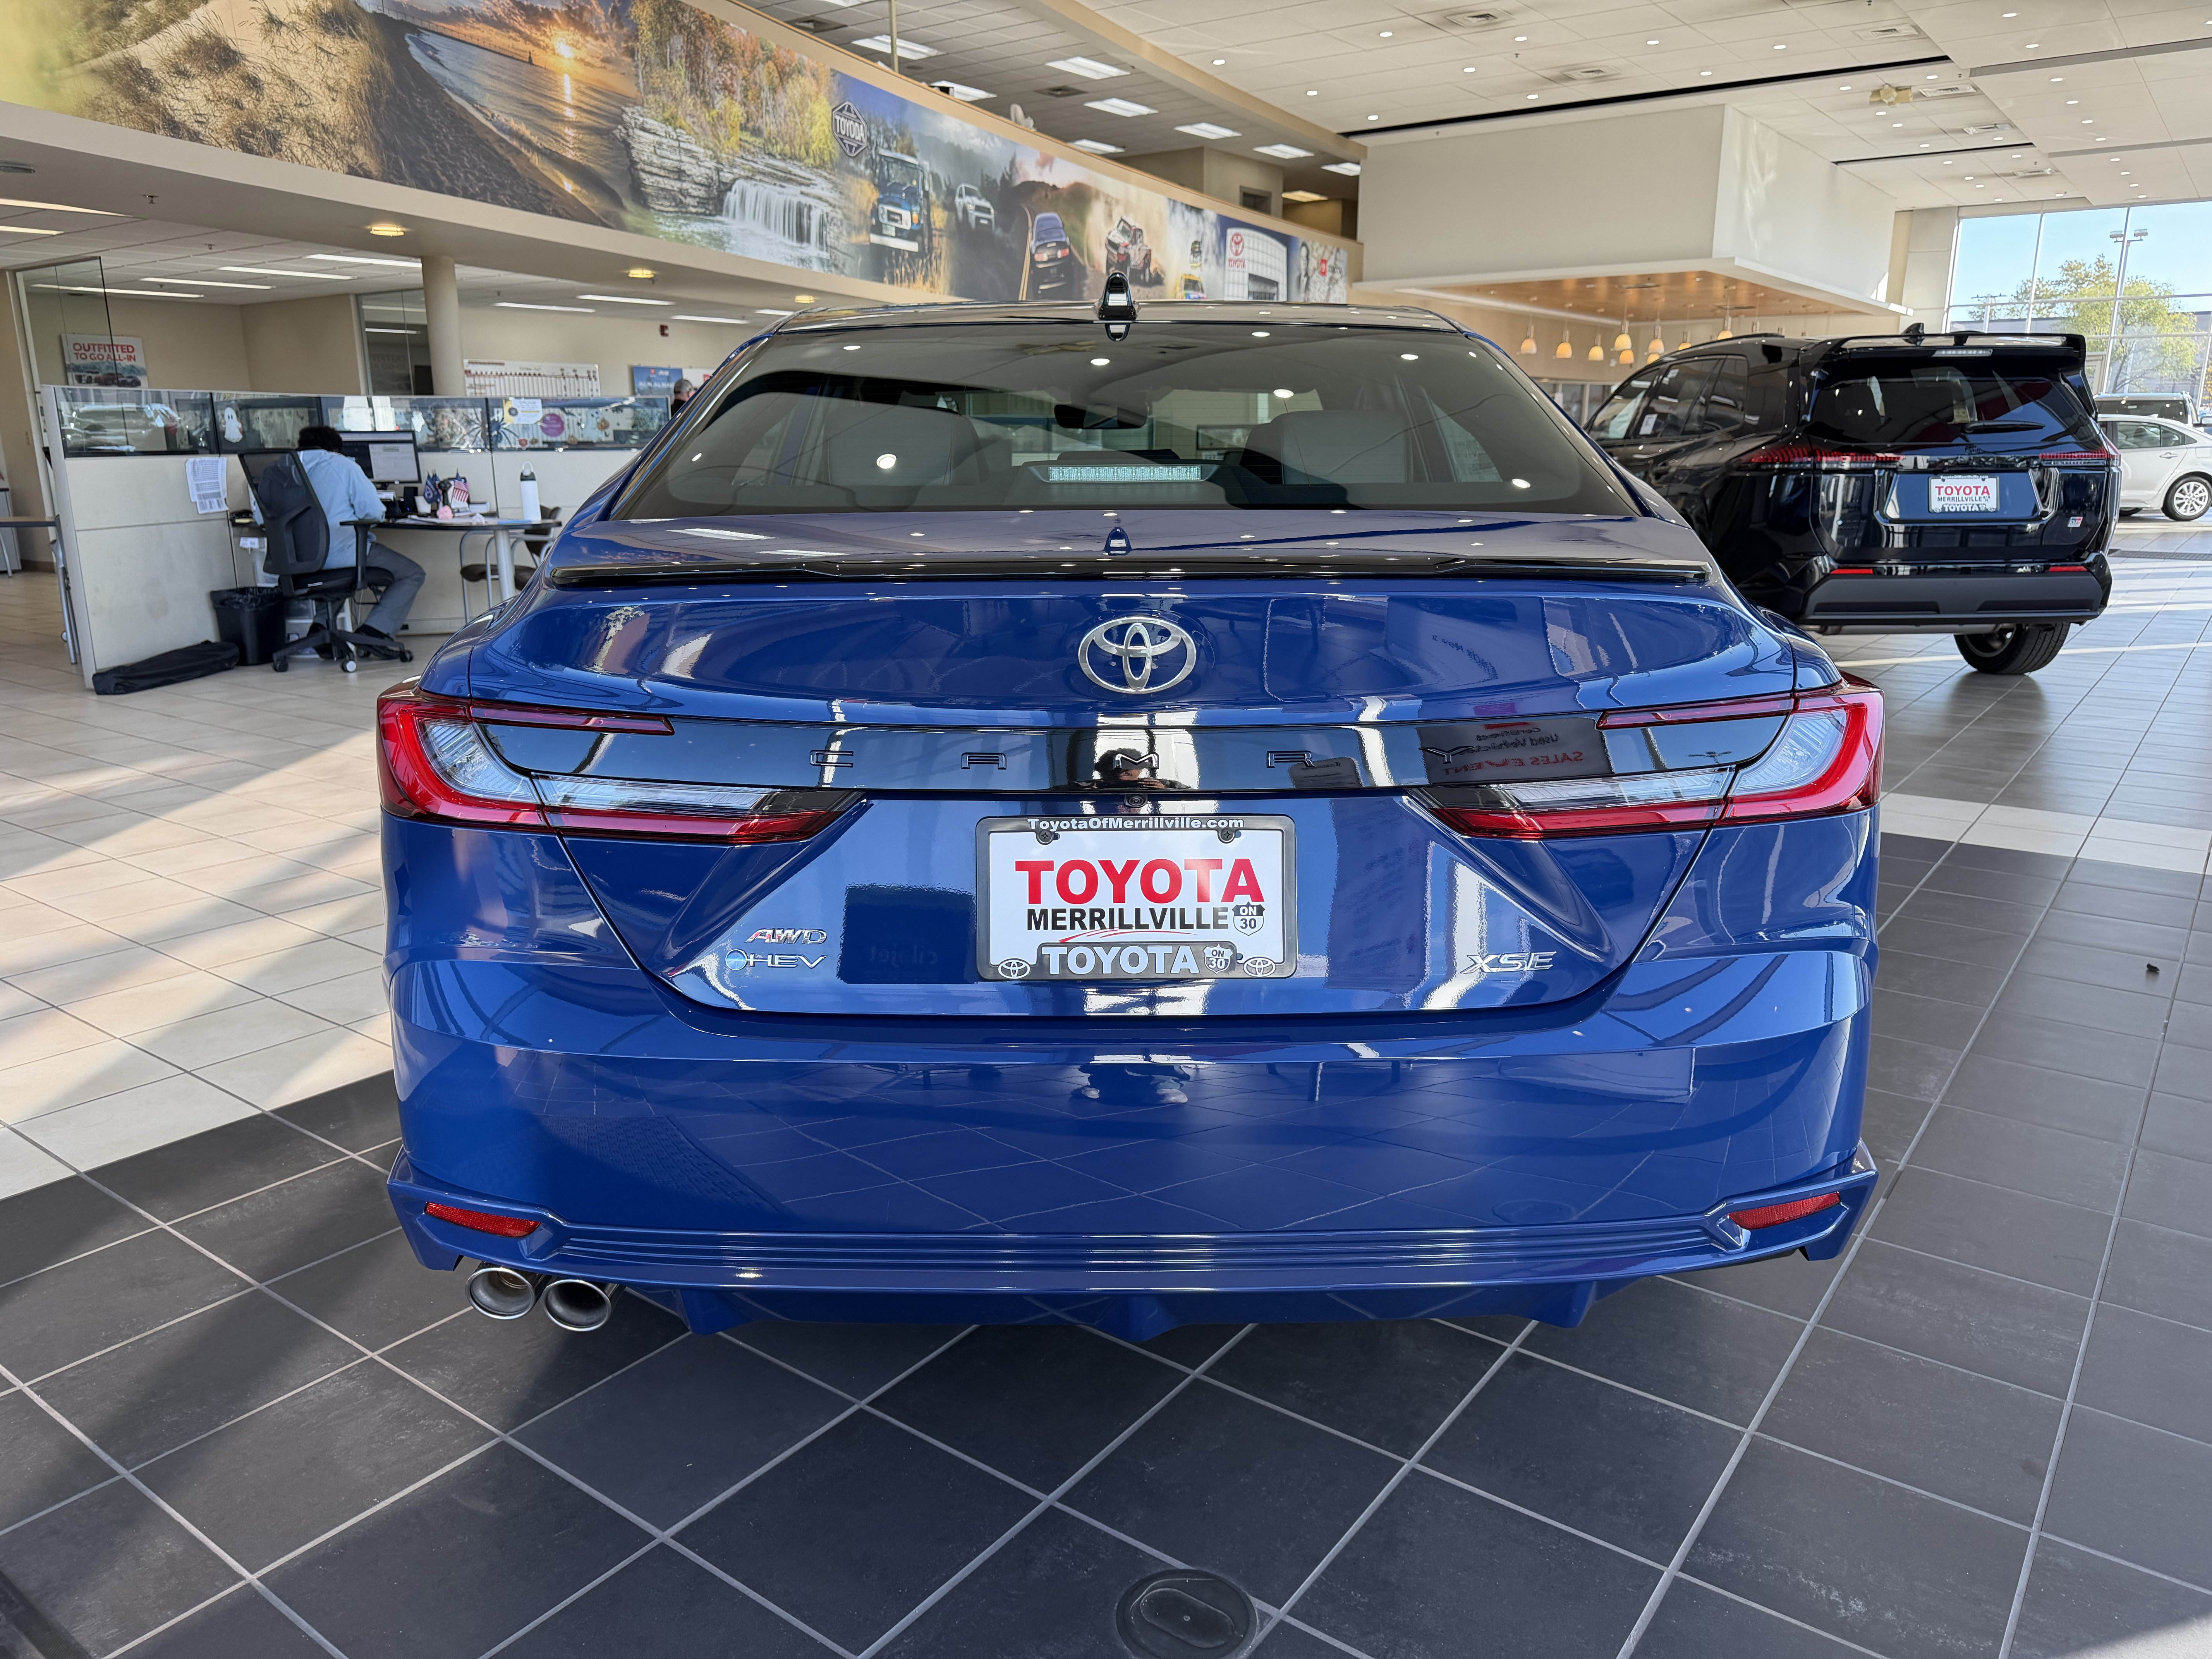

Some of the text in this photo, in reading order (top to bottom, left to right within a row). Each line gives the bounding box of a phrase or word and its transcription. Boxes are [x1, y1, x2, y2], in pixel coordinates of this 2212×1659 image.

[835, 116, 865, 142] TOYODA
[73, 343, 134, 353] OUTFITTED
[1935, 486, 1990, 496] TOYOTA
[1027, 817, 1244, 830] ToyotaOfMerrillville.com
[1015, 859, 1265, 904] TOYOTA
[1240, 906, 1257, 915] ON
[1027, 907, 1229, 930] MERRILLVILLE
[1240, 918, 1257, 929] 30
[744, 928, 827, 944] AWD
[749, 953, 828, 969] HEV
[1042, 946, 1200, 974] TOYOTA
[1211, 950, 1224, 958] ON
[1208, 958, 1225, 969] 30
[1460, 951, 1556, 974] XSE
